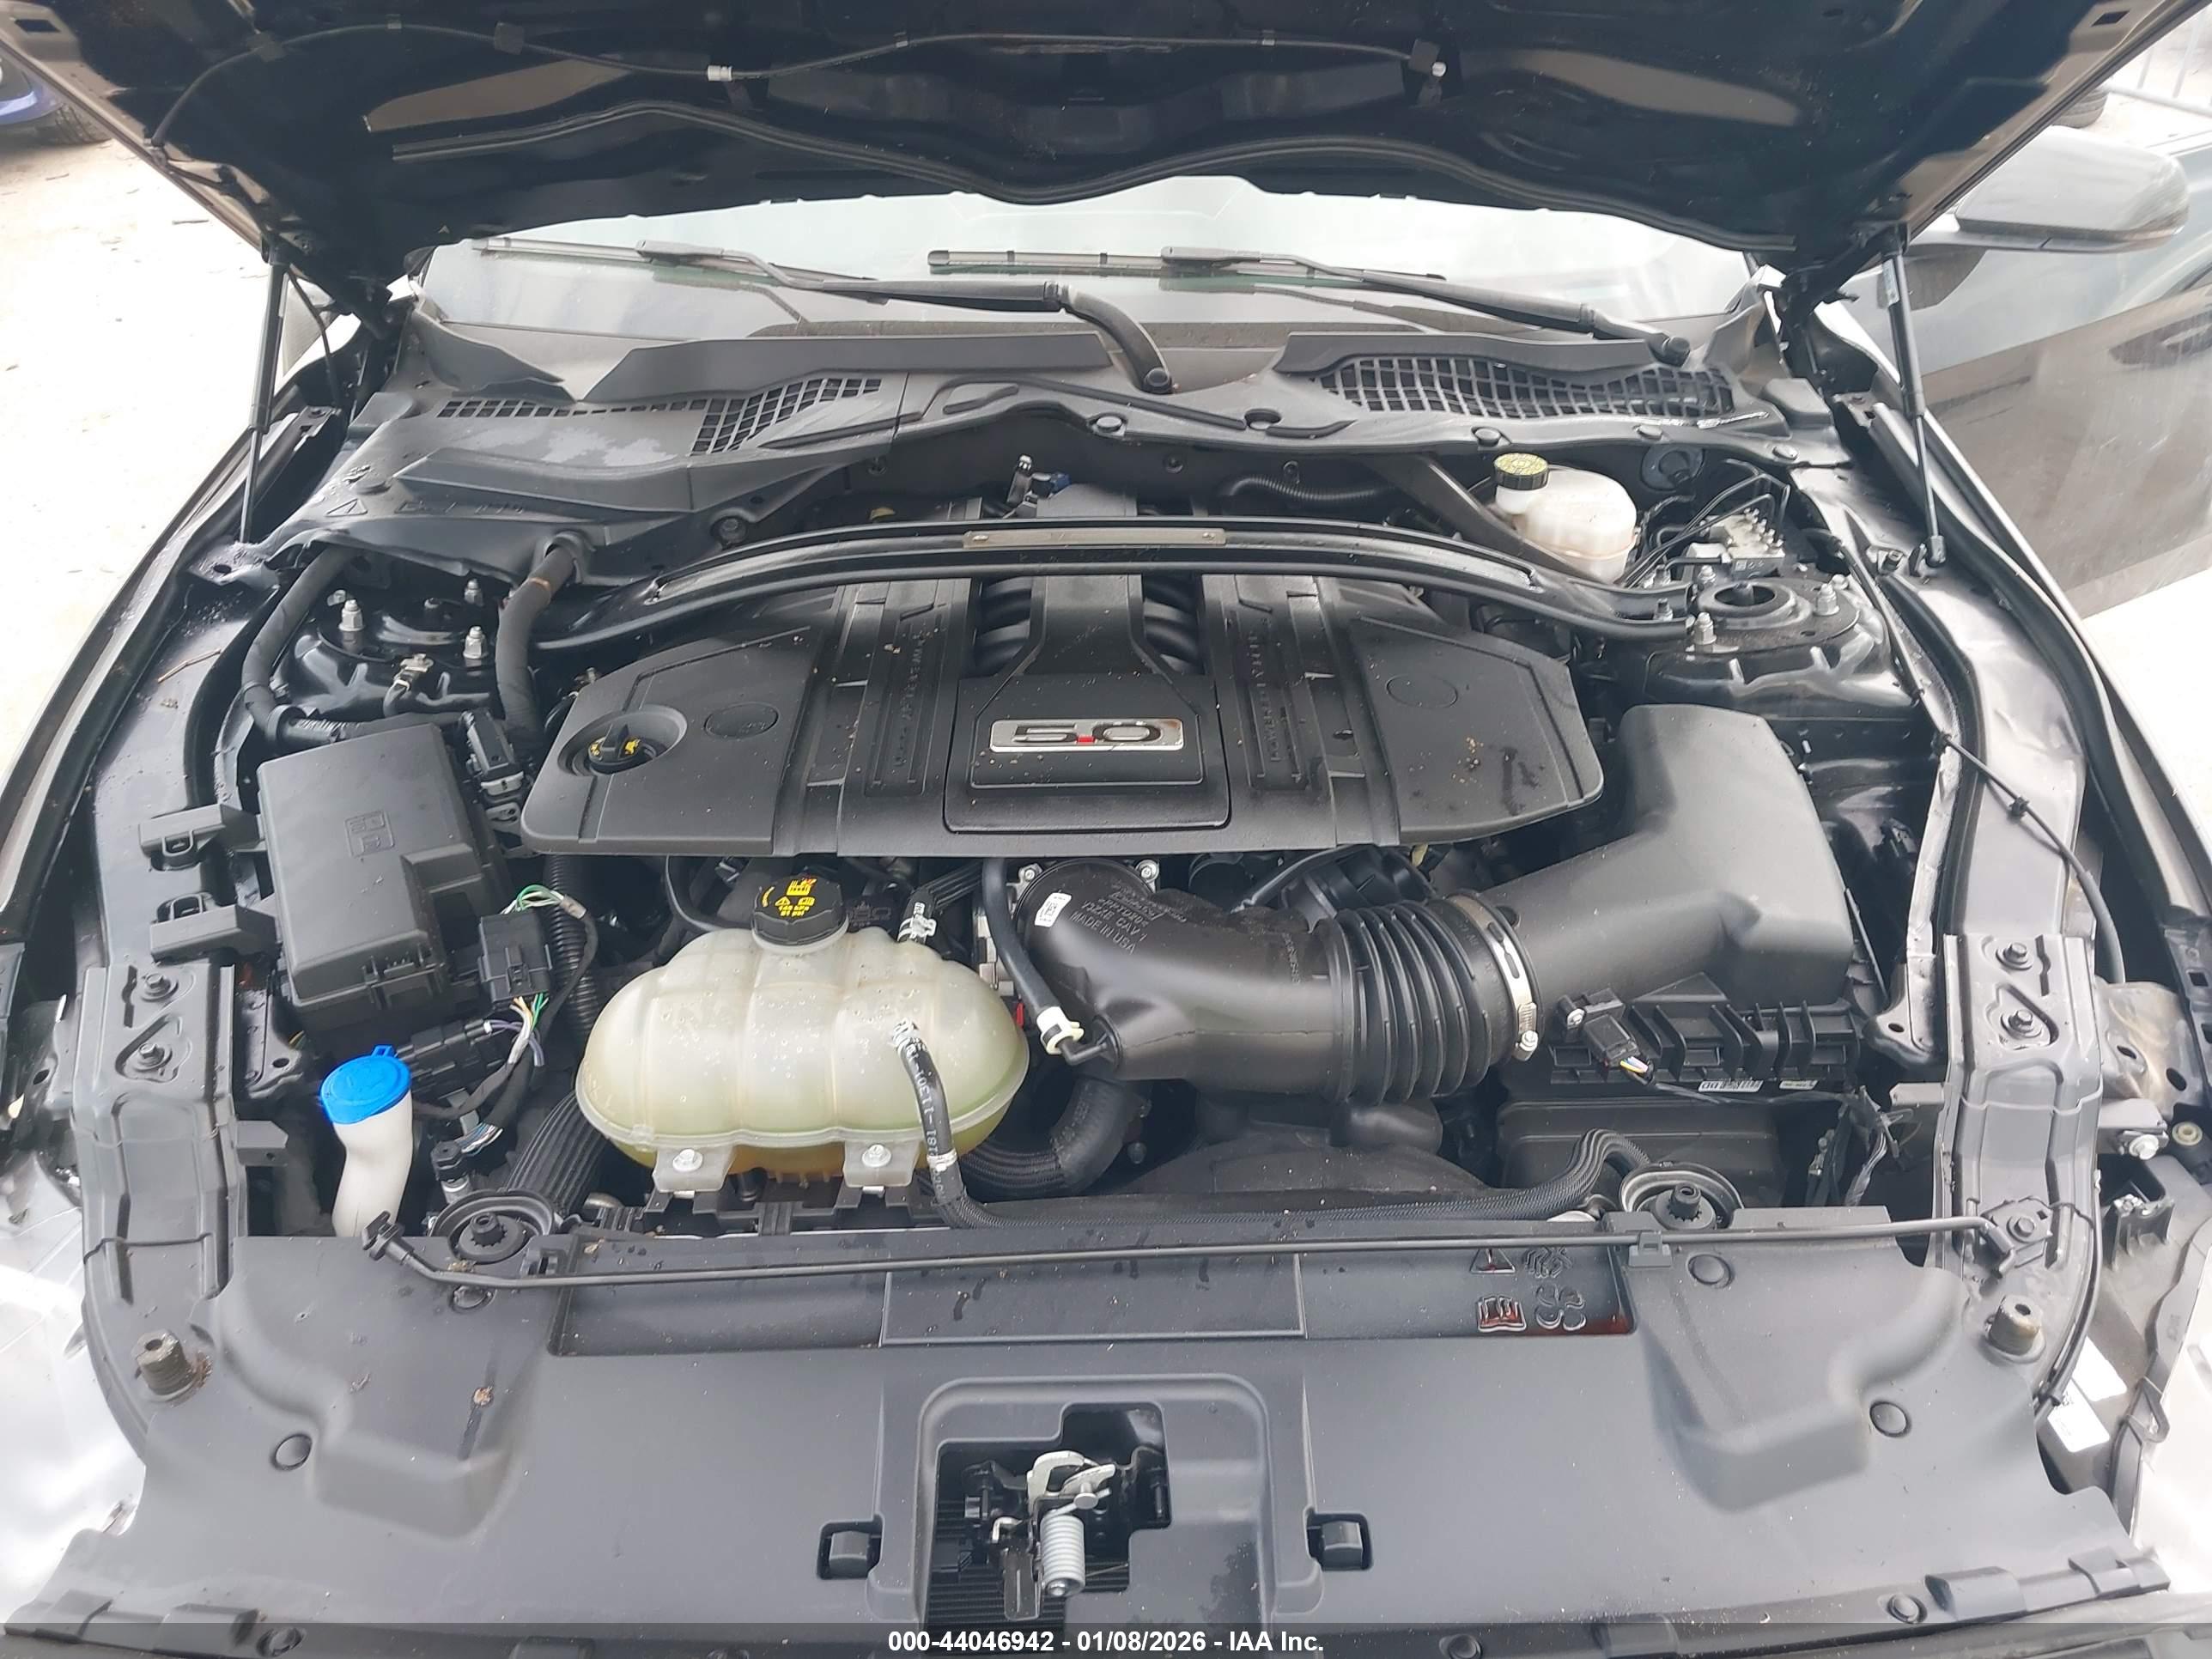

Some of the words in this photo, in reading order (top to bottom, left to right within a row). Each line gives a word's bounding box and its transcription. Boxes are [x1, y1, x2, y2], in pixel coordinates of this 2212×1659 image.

[1012, 722, 1163, 744] 5.0
[1070, 910, 1103, 931] MADE
[1099, 924, 1115, 938] IN
[1112, 930, 1136, 956] USA
